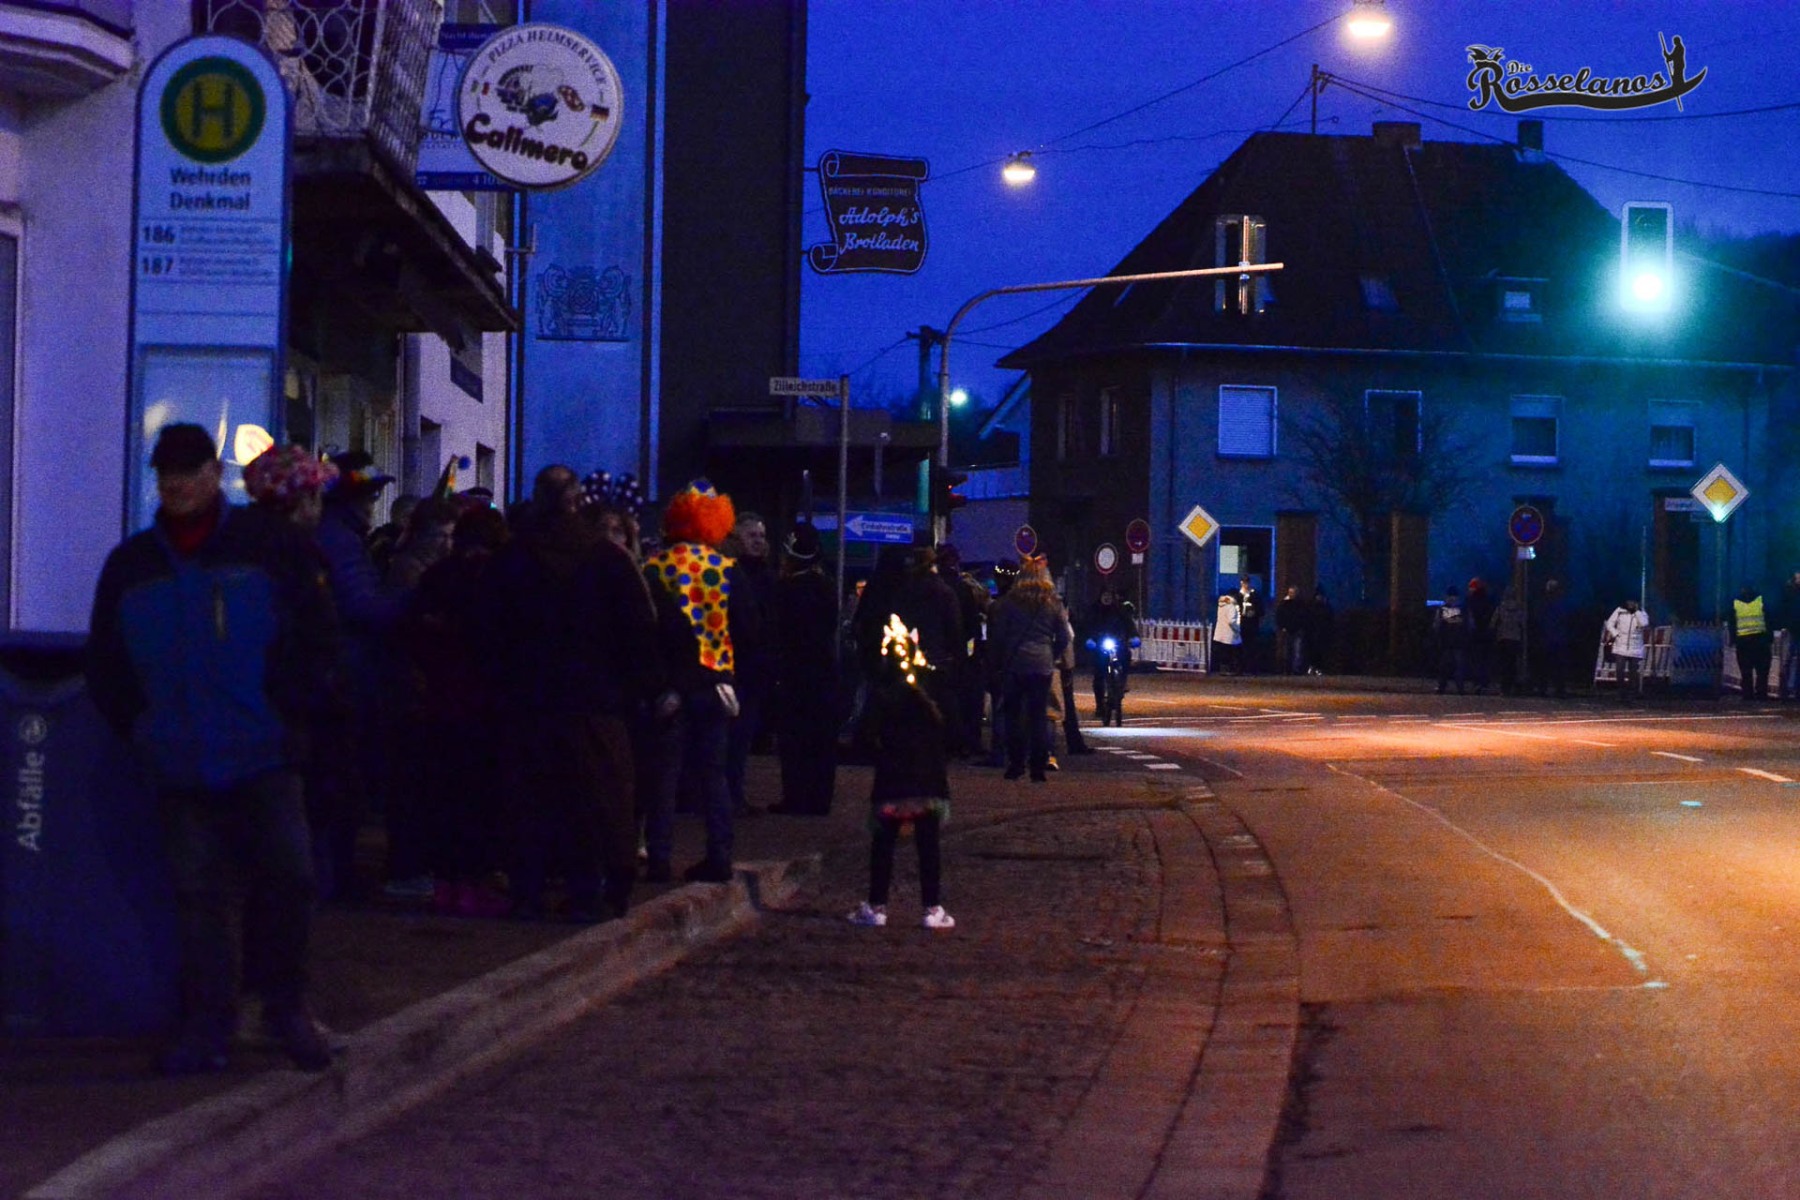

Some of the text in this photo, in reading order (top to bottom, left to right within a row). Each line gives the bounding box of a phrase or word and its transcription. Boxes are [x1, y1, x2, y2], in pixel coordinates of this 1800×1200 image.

[488, 33, 526, 63] PIZZA
[527, 30, 606, 85] HEIMSERVICE
[193, 85, 235, 138] H
[170, 167, 251, 185] Wehrden
[170, 192, 250, 210] Denkmal
[838, 206, 920, 228] Adolph's
[142, 225, 175, 244] 186
[839, 231, 920, 256] Brotladen
[142, 257, 174, 275] 187
[16, 751, 46, 852] Abfälle
